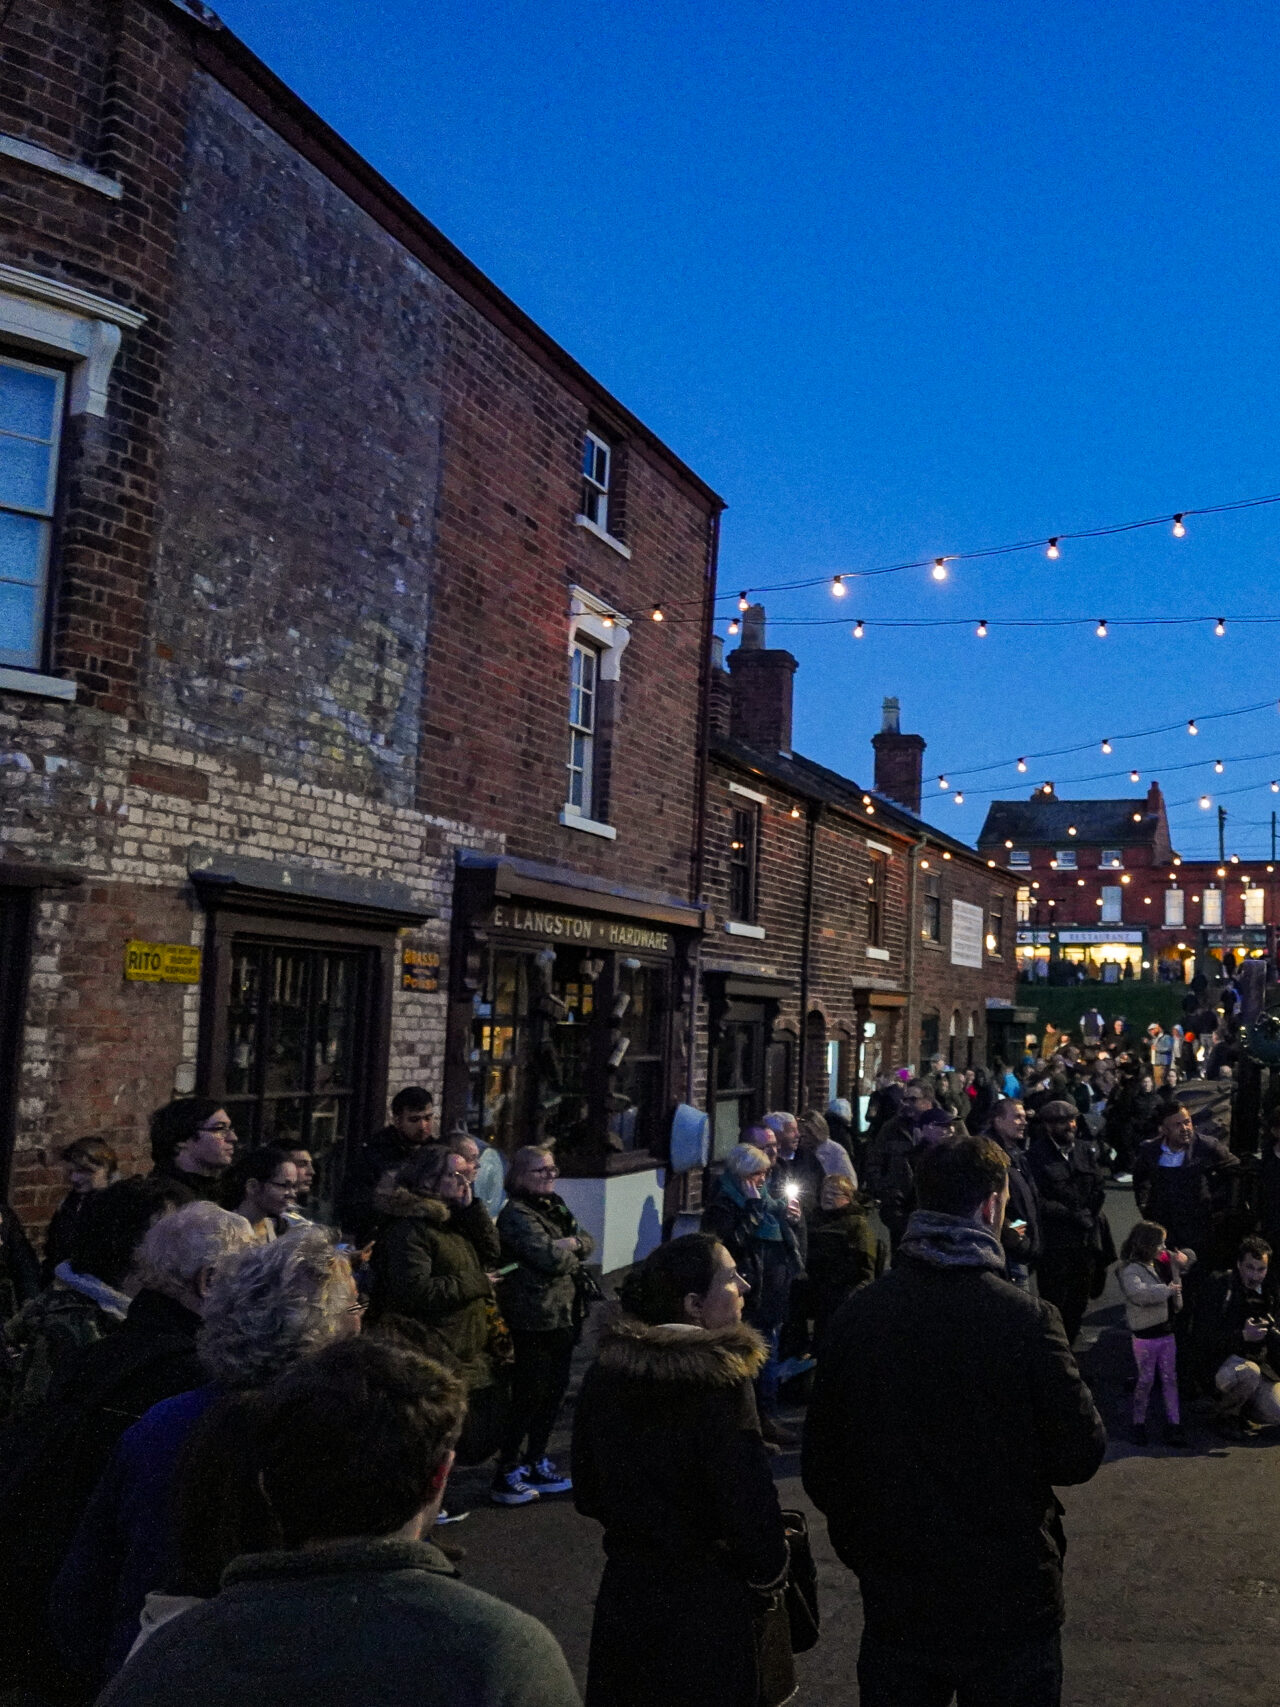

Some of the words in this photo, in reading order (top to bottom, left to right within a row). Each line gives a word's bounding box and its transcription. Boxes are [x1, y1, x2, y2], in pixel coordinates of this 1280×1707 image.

[514, 907, 593, 940] LANGSTON
[609, 924, 668, 951] HARDWARE
[129, 950, 161, 971] RITO
